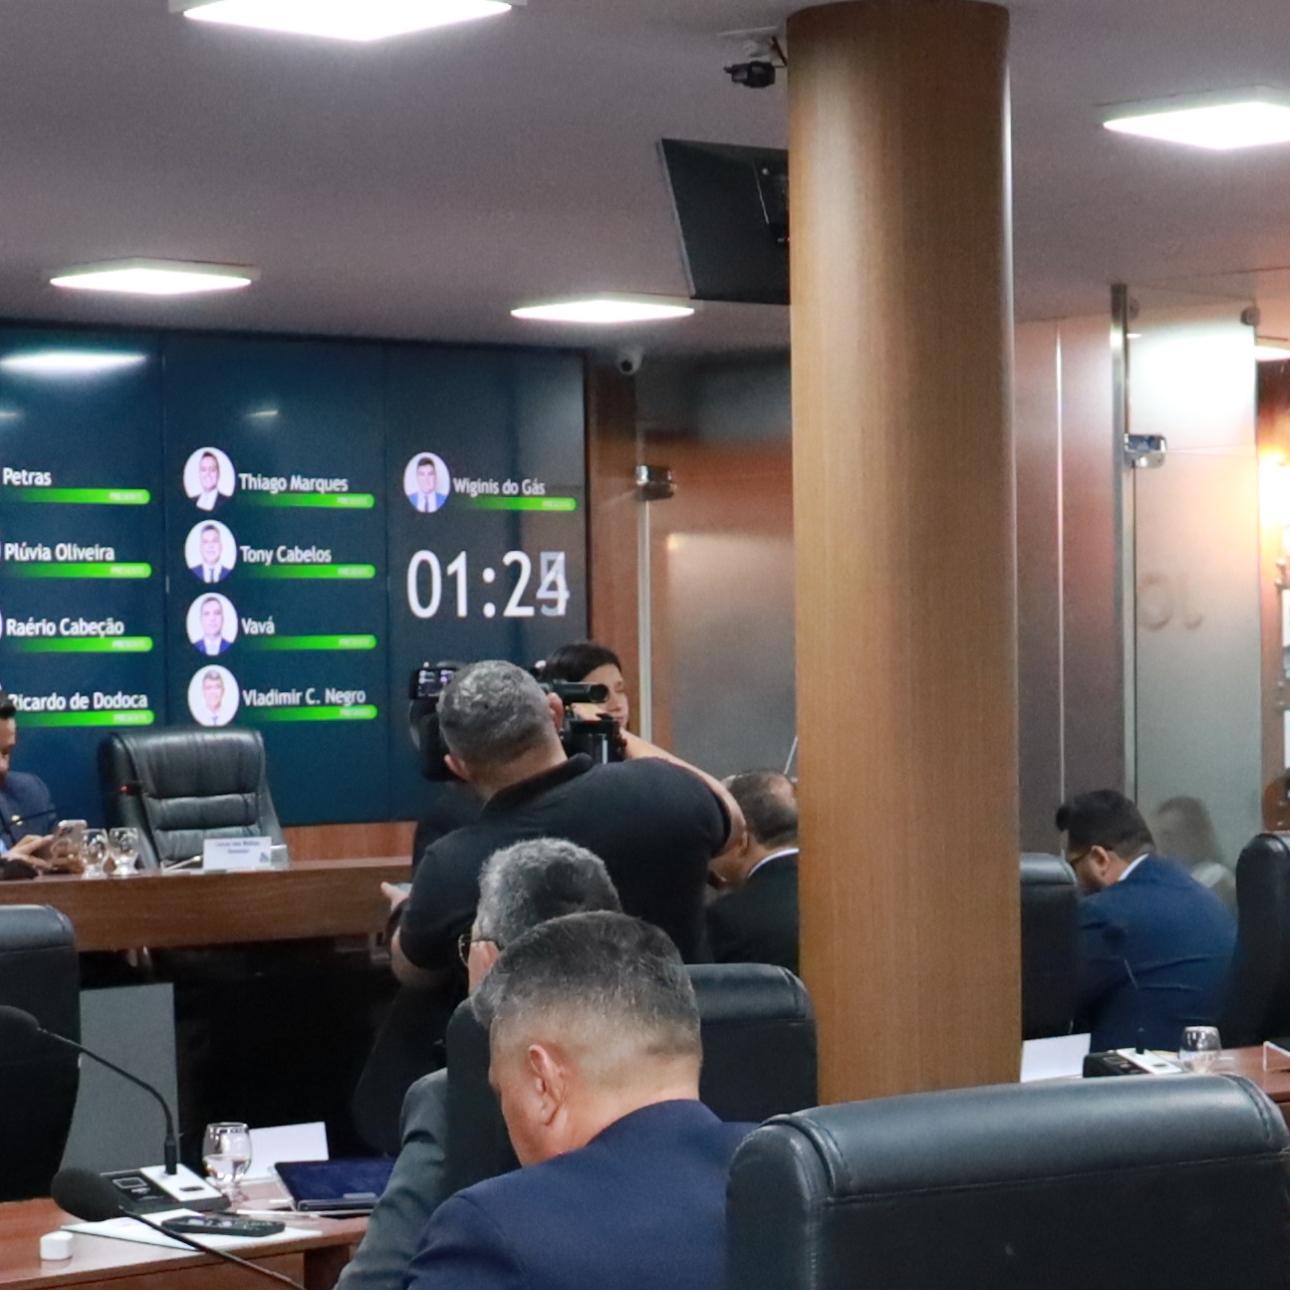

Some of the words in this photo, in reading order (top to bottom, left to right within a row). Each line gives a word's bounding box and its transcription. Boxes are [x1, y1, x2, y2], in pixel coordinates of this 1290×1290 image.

[2, 467, 52, 486] Petras
[239, 473, 287, 495] Thiago
[290, 474, 349, 494] Marques
[502, 478, 519, 495] do
[522, 477, 546, 495] Gás
[4, 541, 51, 561] Plúvia
[55, 543, 115, 561] Oliveira
[239, 545, 273, 565] Tony
[277, 545, 332, 563] Cabelos
[6, 616, 56, 636] Raério
[59, 617, 125, 639] Cabeção
[241, 615, 275, 635] Vavá
[69, 692, 90, 710] de
[93, 692, 148, 710] Dodoca
[242, 688, 303, 706] Vladimir
[305, 688, 320, 705] C.
[325, 688, 366, 707] Negro
